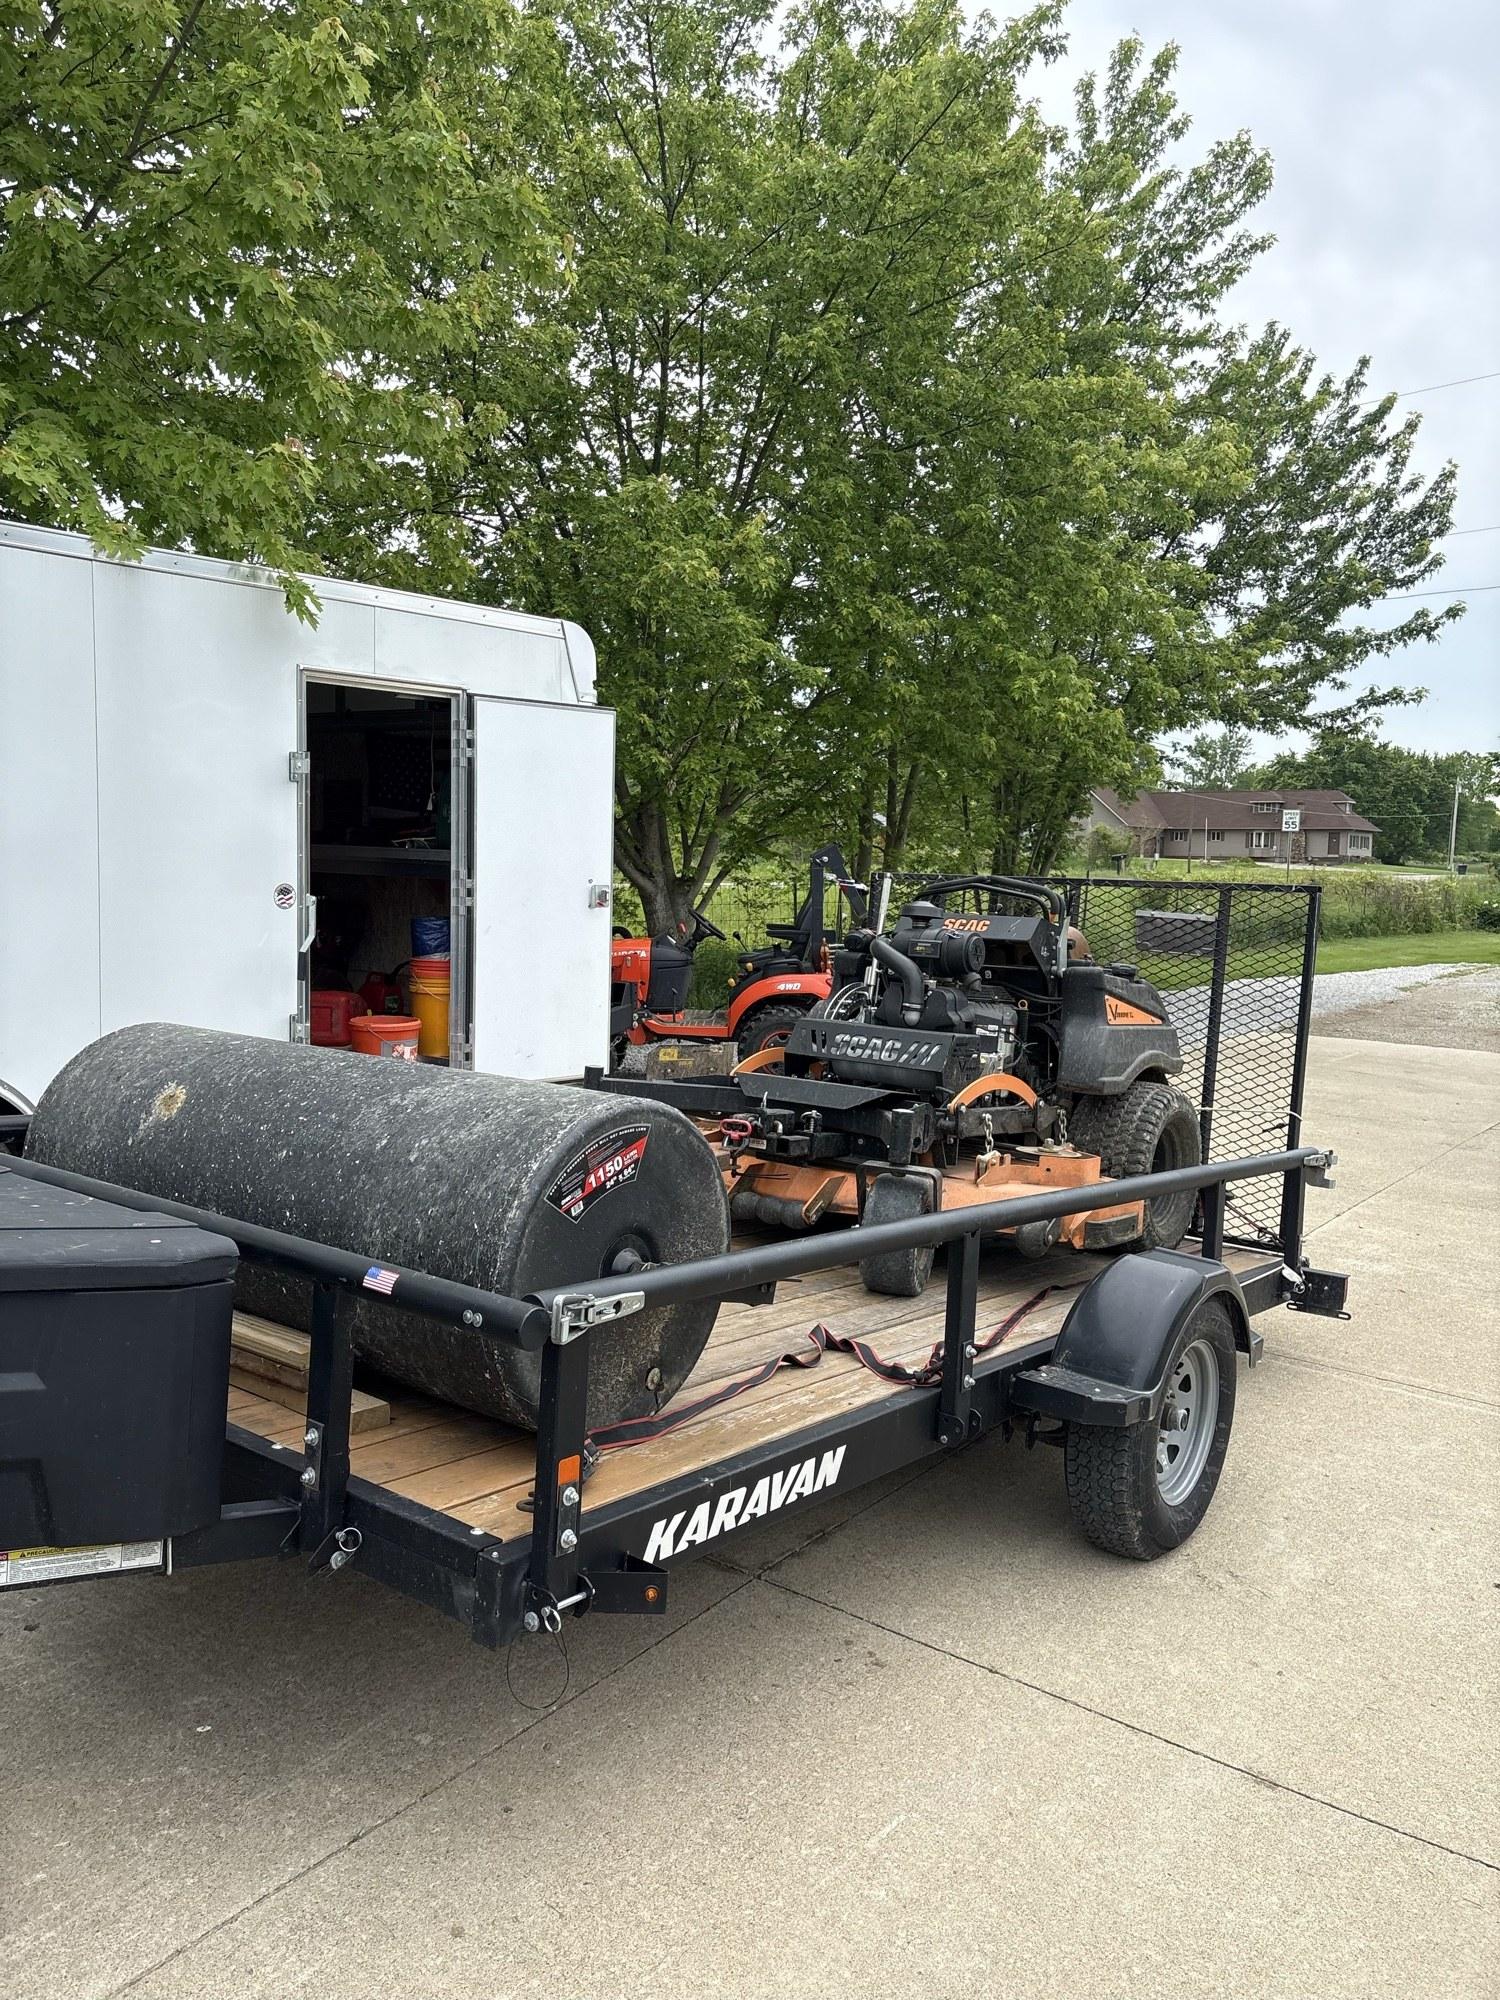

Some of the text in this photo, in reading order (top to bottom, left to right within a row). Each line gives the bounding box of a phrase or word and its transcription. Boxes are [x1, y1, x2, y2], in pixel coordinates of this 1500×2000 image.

[1284, 820, 1298, 829] 55
[942, 918, 991, 932] SCAG
[776, 982, 801, 991] 4WD
[830, 1033, 902, 1062] SCAG
[588, 1155, 623, 1189] 1150
[642, 1444, 847, 1564] KARAVAN
